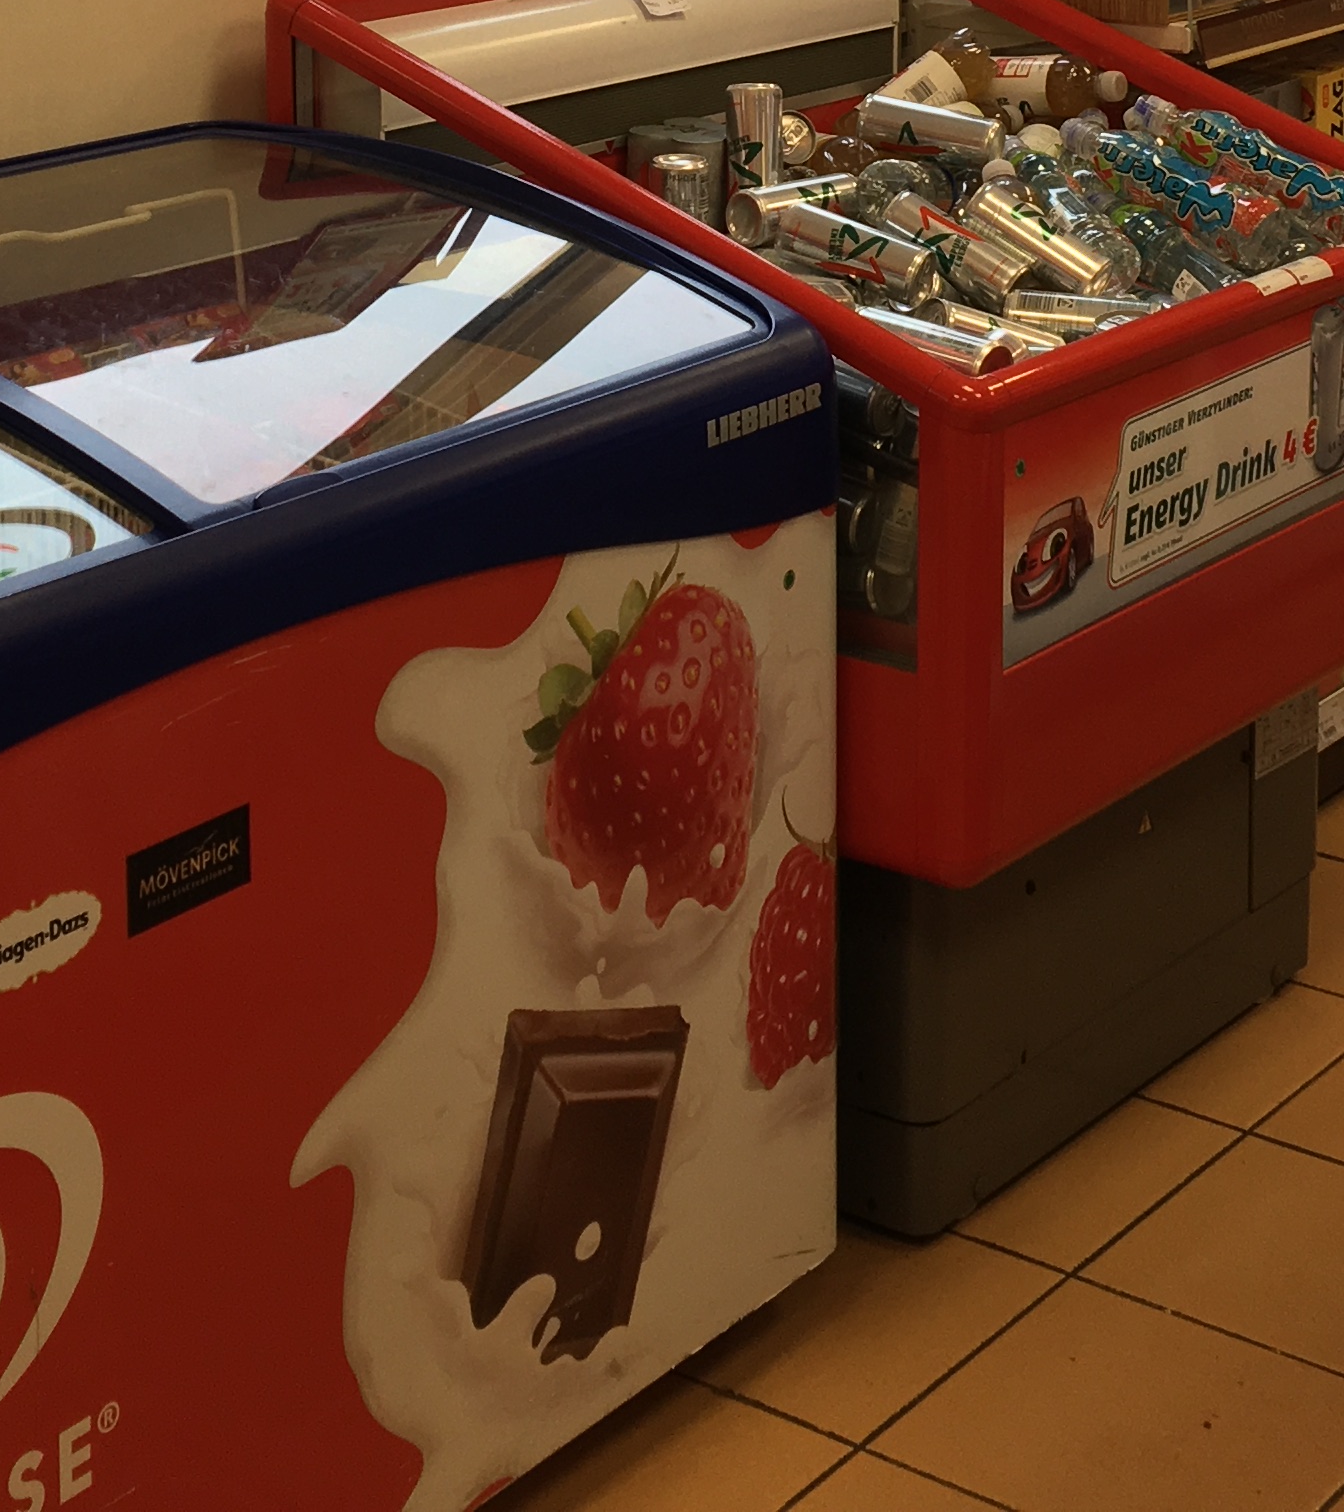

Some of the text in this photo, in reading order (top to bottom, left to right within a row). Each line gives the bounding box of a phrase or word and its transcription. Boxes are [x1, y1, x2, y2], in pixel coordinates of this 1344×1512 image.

[706, 380, 823, 449] LIEBHERR
[1130, 416, 1185, 453] GÜNSTIGER
[1123, 478, 1209, 546] Energy
[1214, 438, 1278, 501] Drink
[1281, 430, 1297, 464] 4
[1302, 418, 1318, 456] €
[1128, 446, 1187, 495] unser
[138, 836, 241, 900] MÖVENPICK
